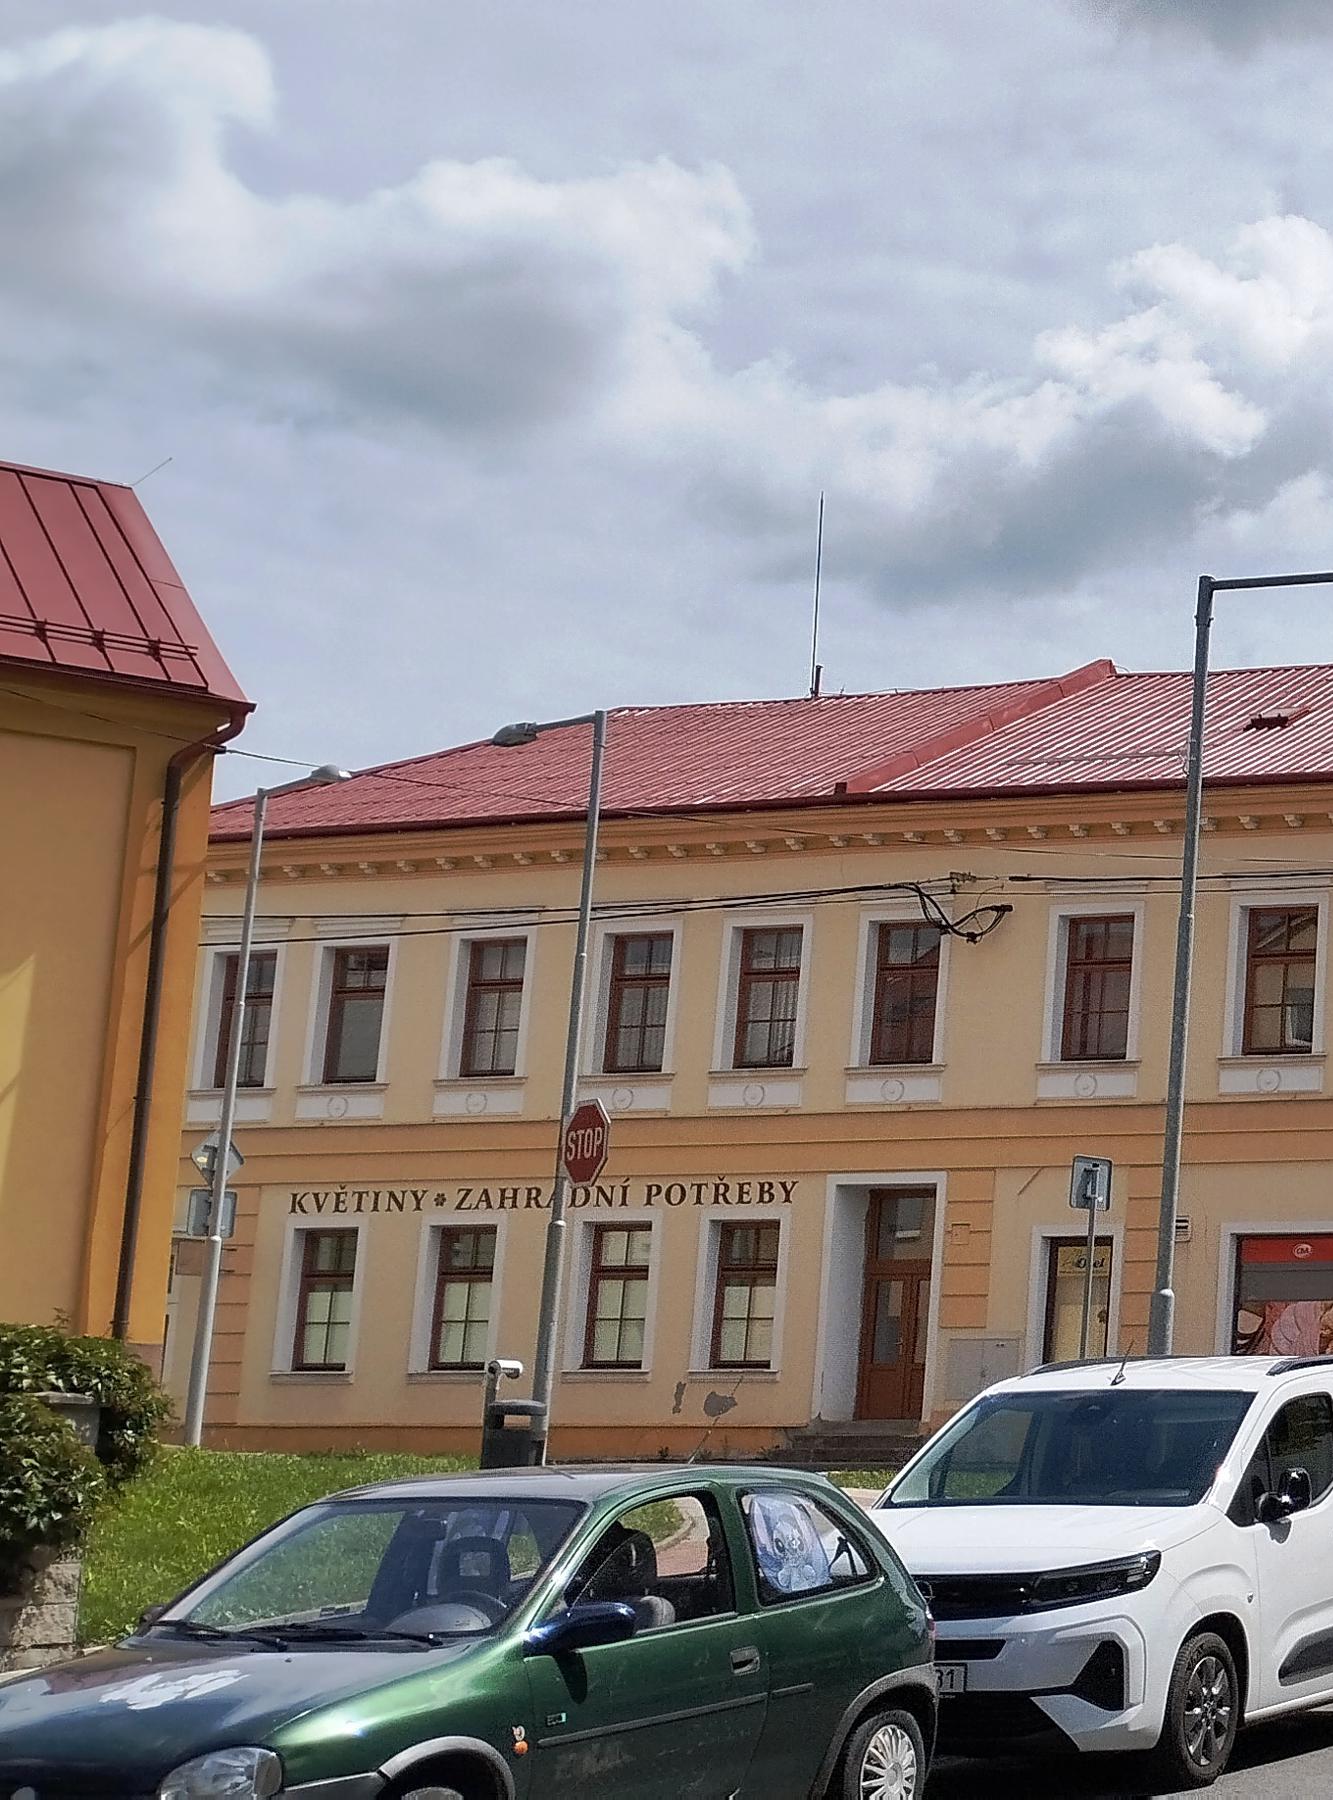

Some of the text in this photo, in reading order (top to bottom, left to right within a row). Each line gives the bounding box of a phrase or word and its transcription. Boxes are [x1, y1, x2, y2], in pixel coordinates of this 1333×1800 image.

[566, 1127, 602, 1160] STOP
[288, 1186, 428, 1215] KVĚTINY
[644, 1176, 800, 1207] POTŘEBY
